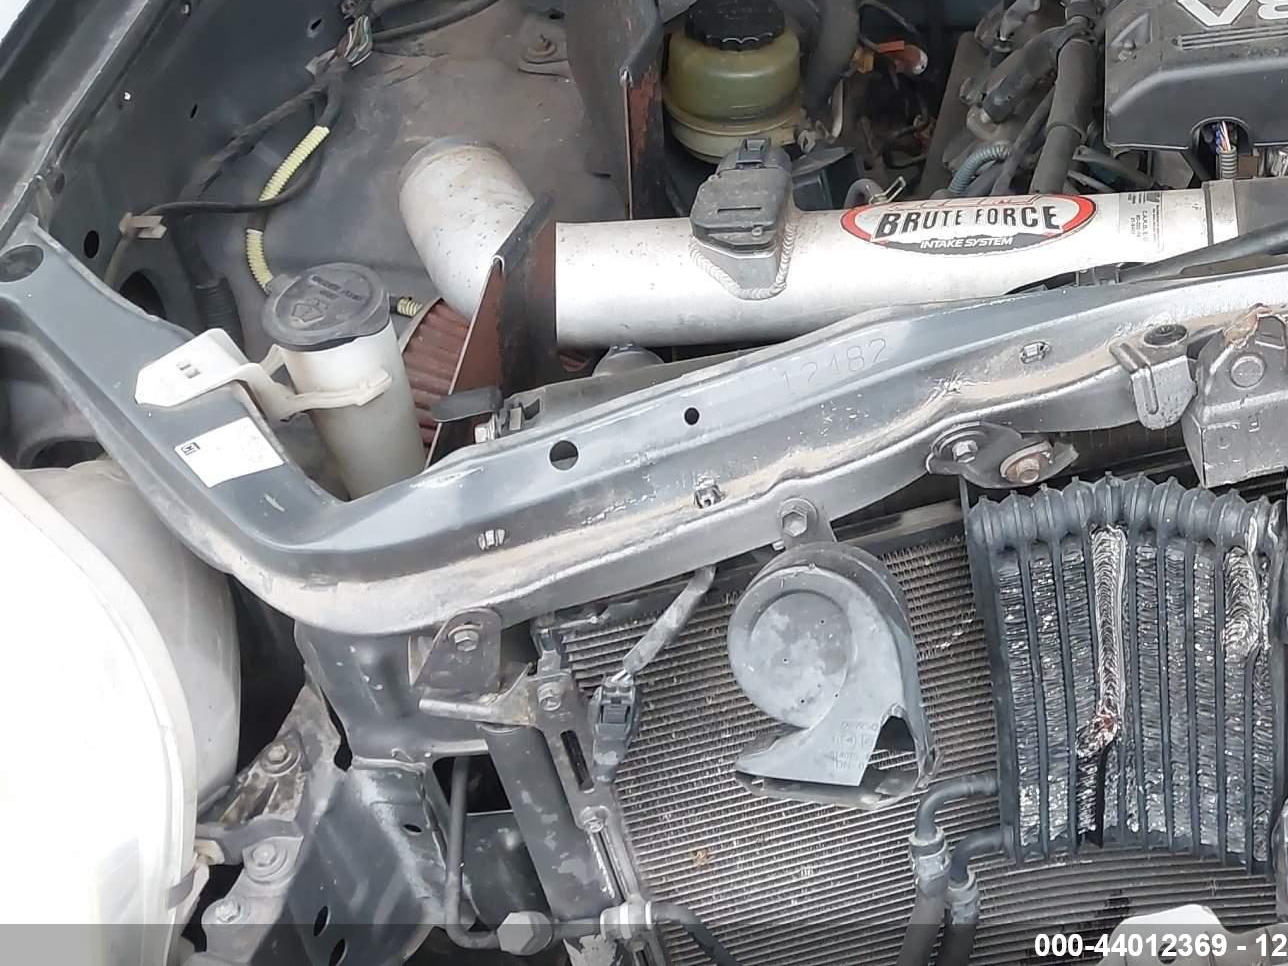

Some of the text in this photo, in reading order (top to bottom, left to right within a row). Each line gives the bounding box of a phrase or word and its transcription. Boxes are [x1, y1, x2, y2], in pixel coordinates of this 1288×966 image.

[874, 205, 1060, 238] BRUTE FORCE
[920, 235, 1013, 249] INTAKE SYSTEM
